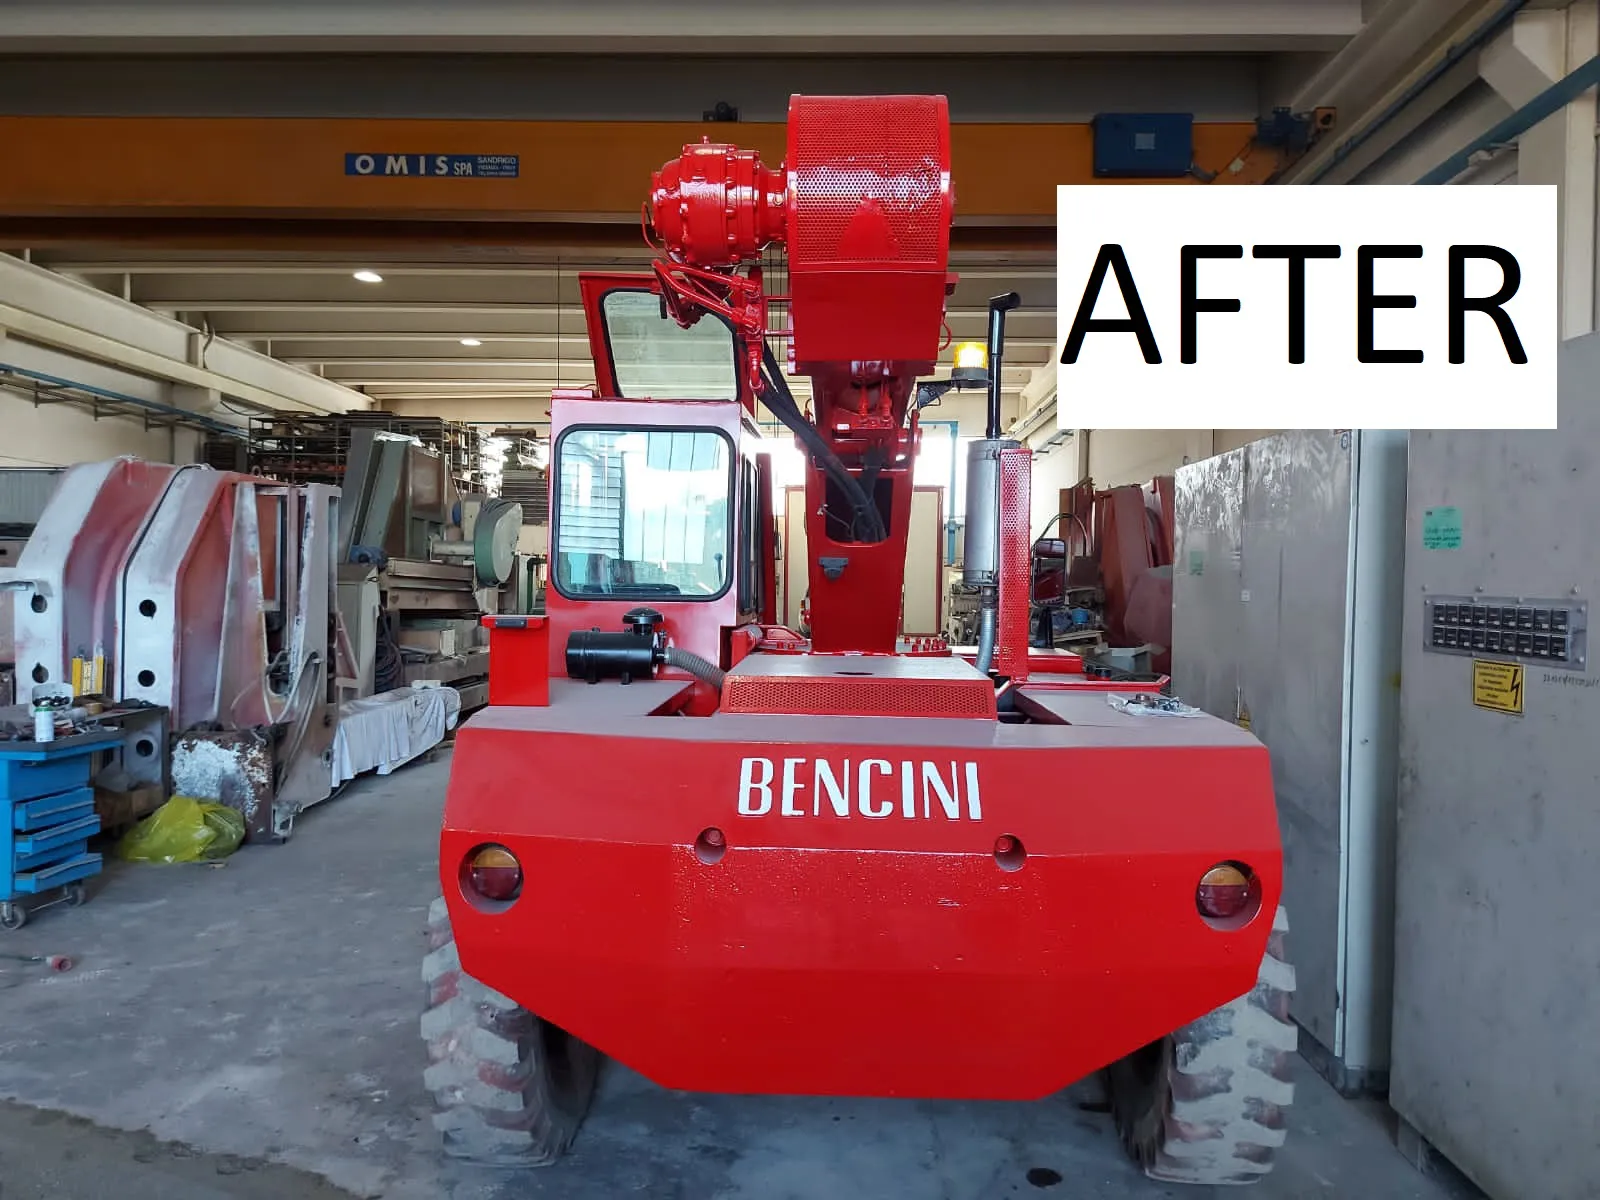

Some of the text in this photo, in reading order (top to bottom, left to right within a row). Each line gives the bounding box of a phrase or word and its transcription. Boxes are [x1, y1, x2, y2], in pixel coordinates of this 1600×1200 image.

[355, 155, 473, 176] OMIS SPA
[738, 757, 981, 820] BENCINI
